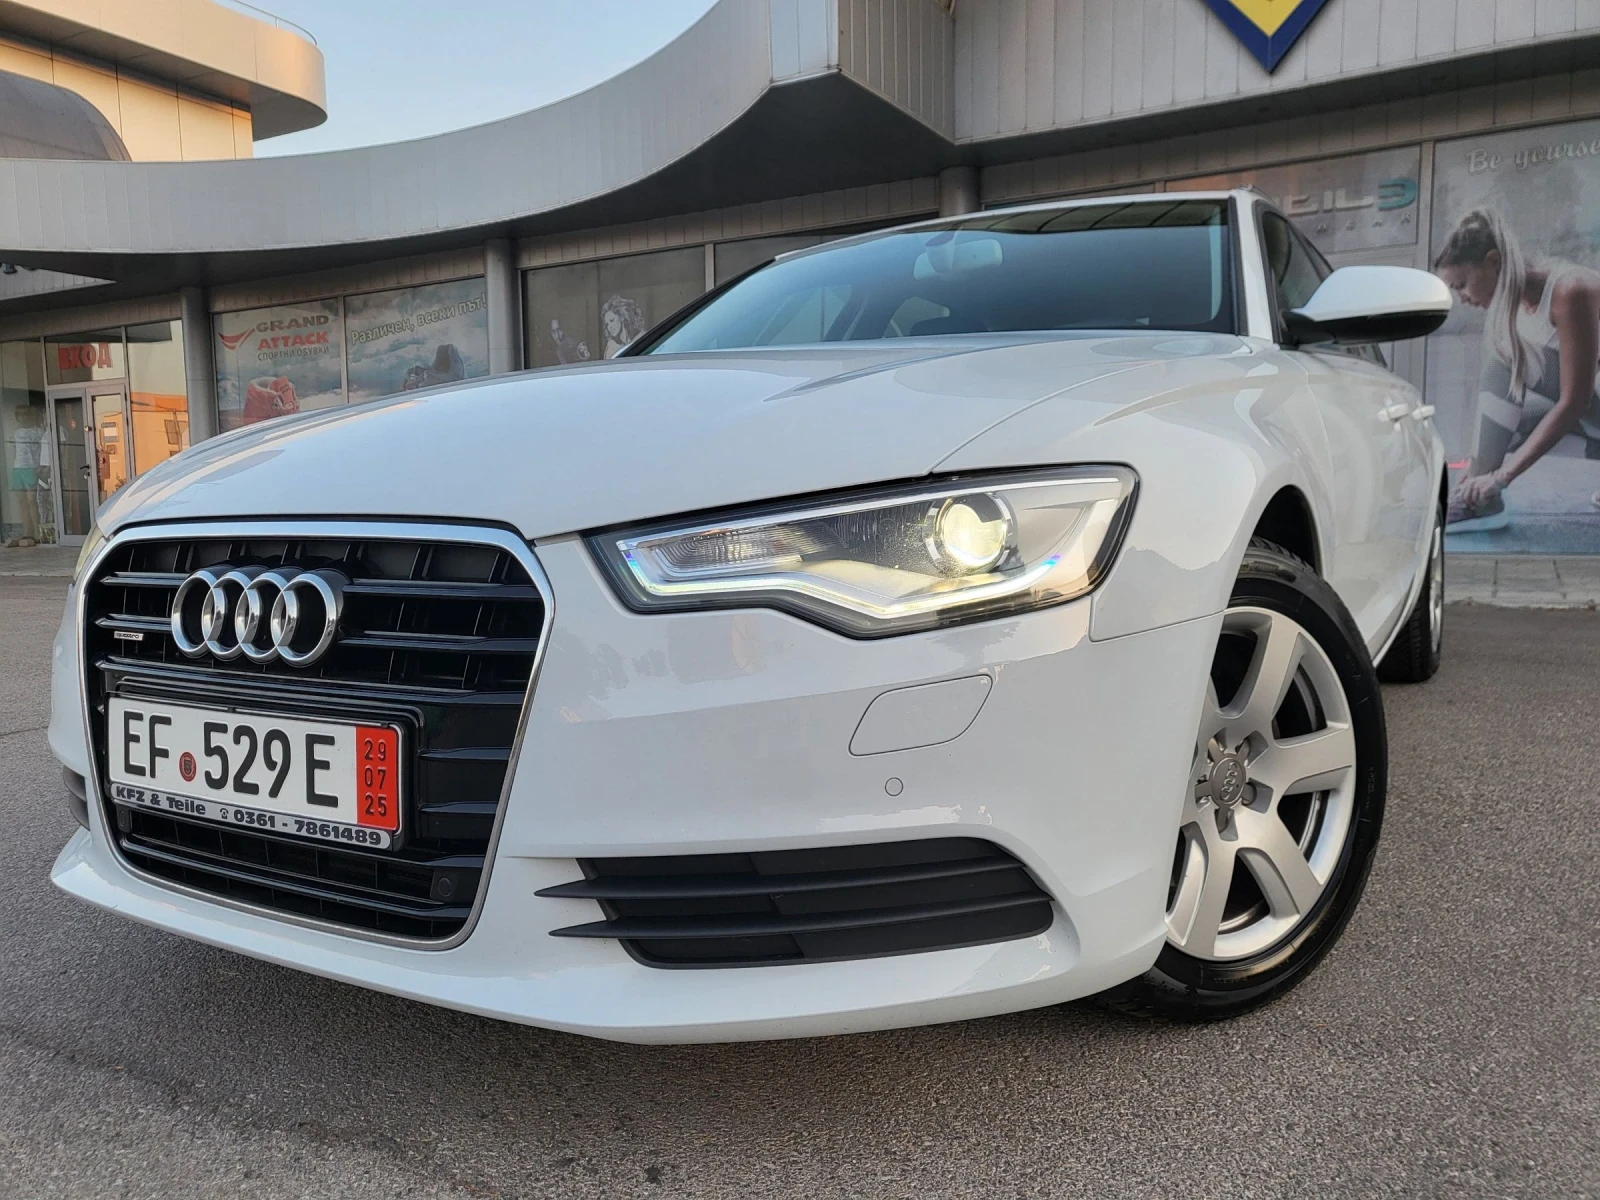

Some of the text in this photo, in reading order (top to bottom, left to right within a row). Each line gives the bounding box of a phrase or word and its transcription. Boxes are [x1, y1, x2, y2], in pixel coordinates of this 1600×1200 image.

[1464, 147, 1501, 174] Be
[255, 314, 329, 333] GRAND
[351, 292, 488, 345] Различен, всеки път!
[257, 331, 329, 350] ATTACK
[57, 342, 113, 370] ВХОД
[257, 346, 330, 362] СПОРТНИ ОБУВКИ
[123, 710, 339, 808] EF 529 E
[364, 739, 387, 762] 29
[364, 766, 387, 790] 07
[116, 785, 145, 803] KFZ
[150, 793, 161, 806] &
[166, 796, 206, 815] Teile
[233, 809, 276, 829] 0361
[294, 819, 382, 846] 7861489
[364, 793, 387, 817] 25
